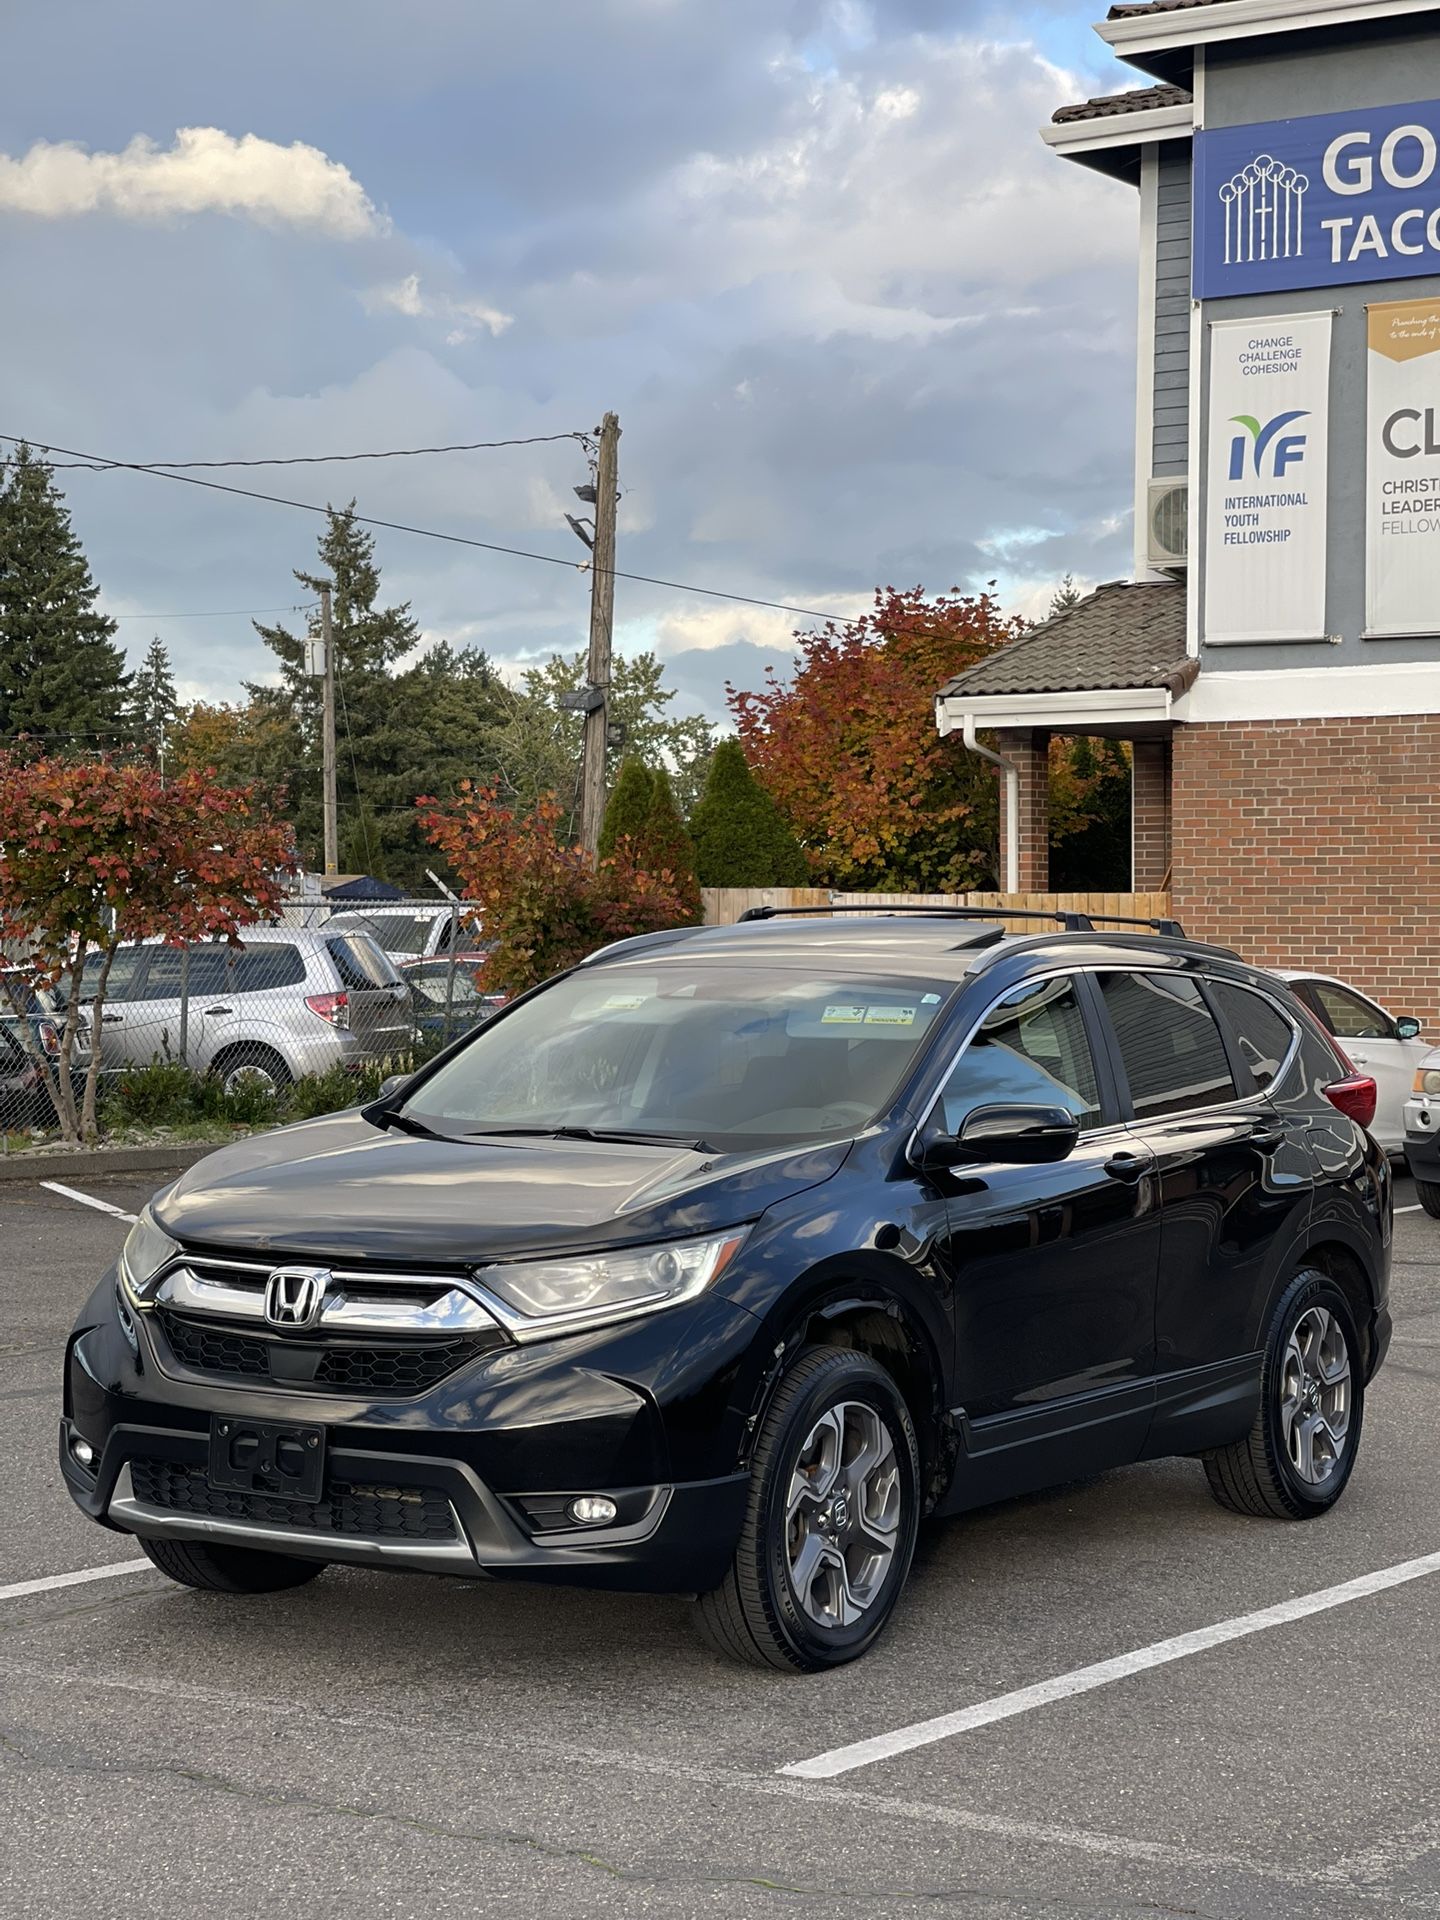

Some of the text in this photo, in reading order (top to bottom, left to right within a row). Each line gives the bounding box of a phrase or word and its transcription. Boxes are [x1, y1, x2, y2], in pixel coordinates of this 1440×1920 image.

[1322, 125, 1437, 195] GO
[1248, 336, 1293, 350] CHANGE
[1238, 348, 1302, 364] CHALLENGE
[1242, 361, 1298, 376] COHESION
[1227, 410, 1312, 481] IYF
[1224, 492, 1308, 510] INTERNATIONAL
[1224, 513, 1259, 528] YOUTH
[1223, 529, 1291, 546] FELLOWSHIP
